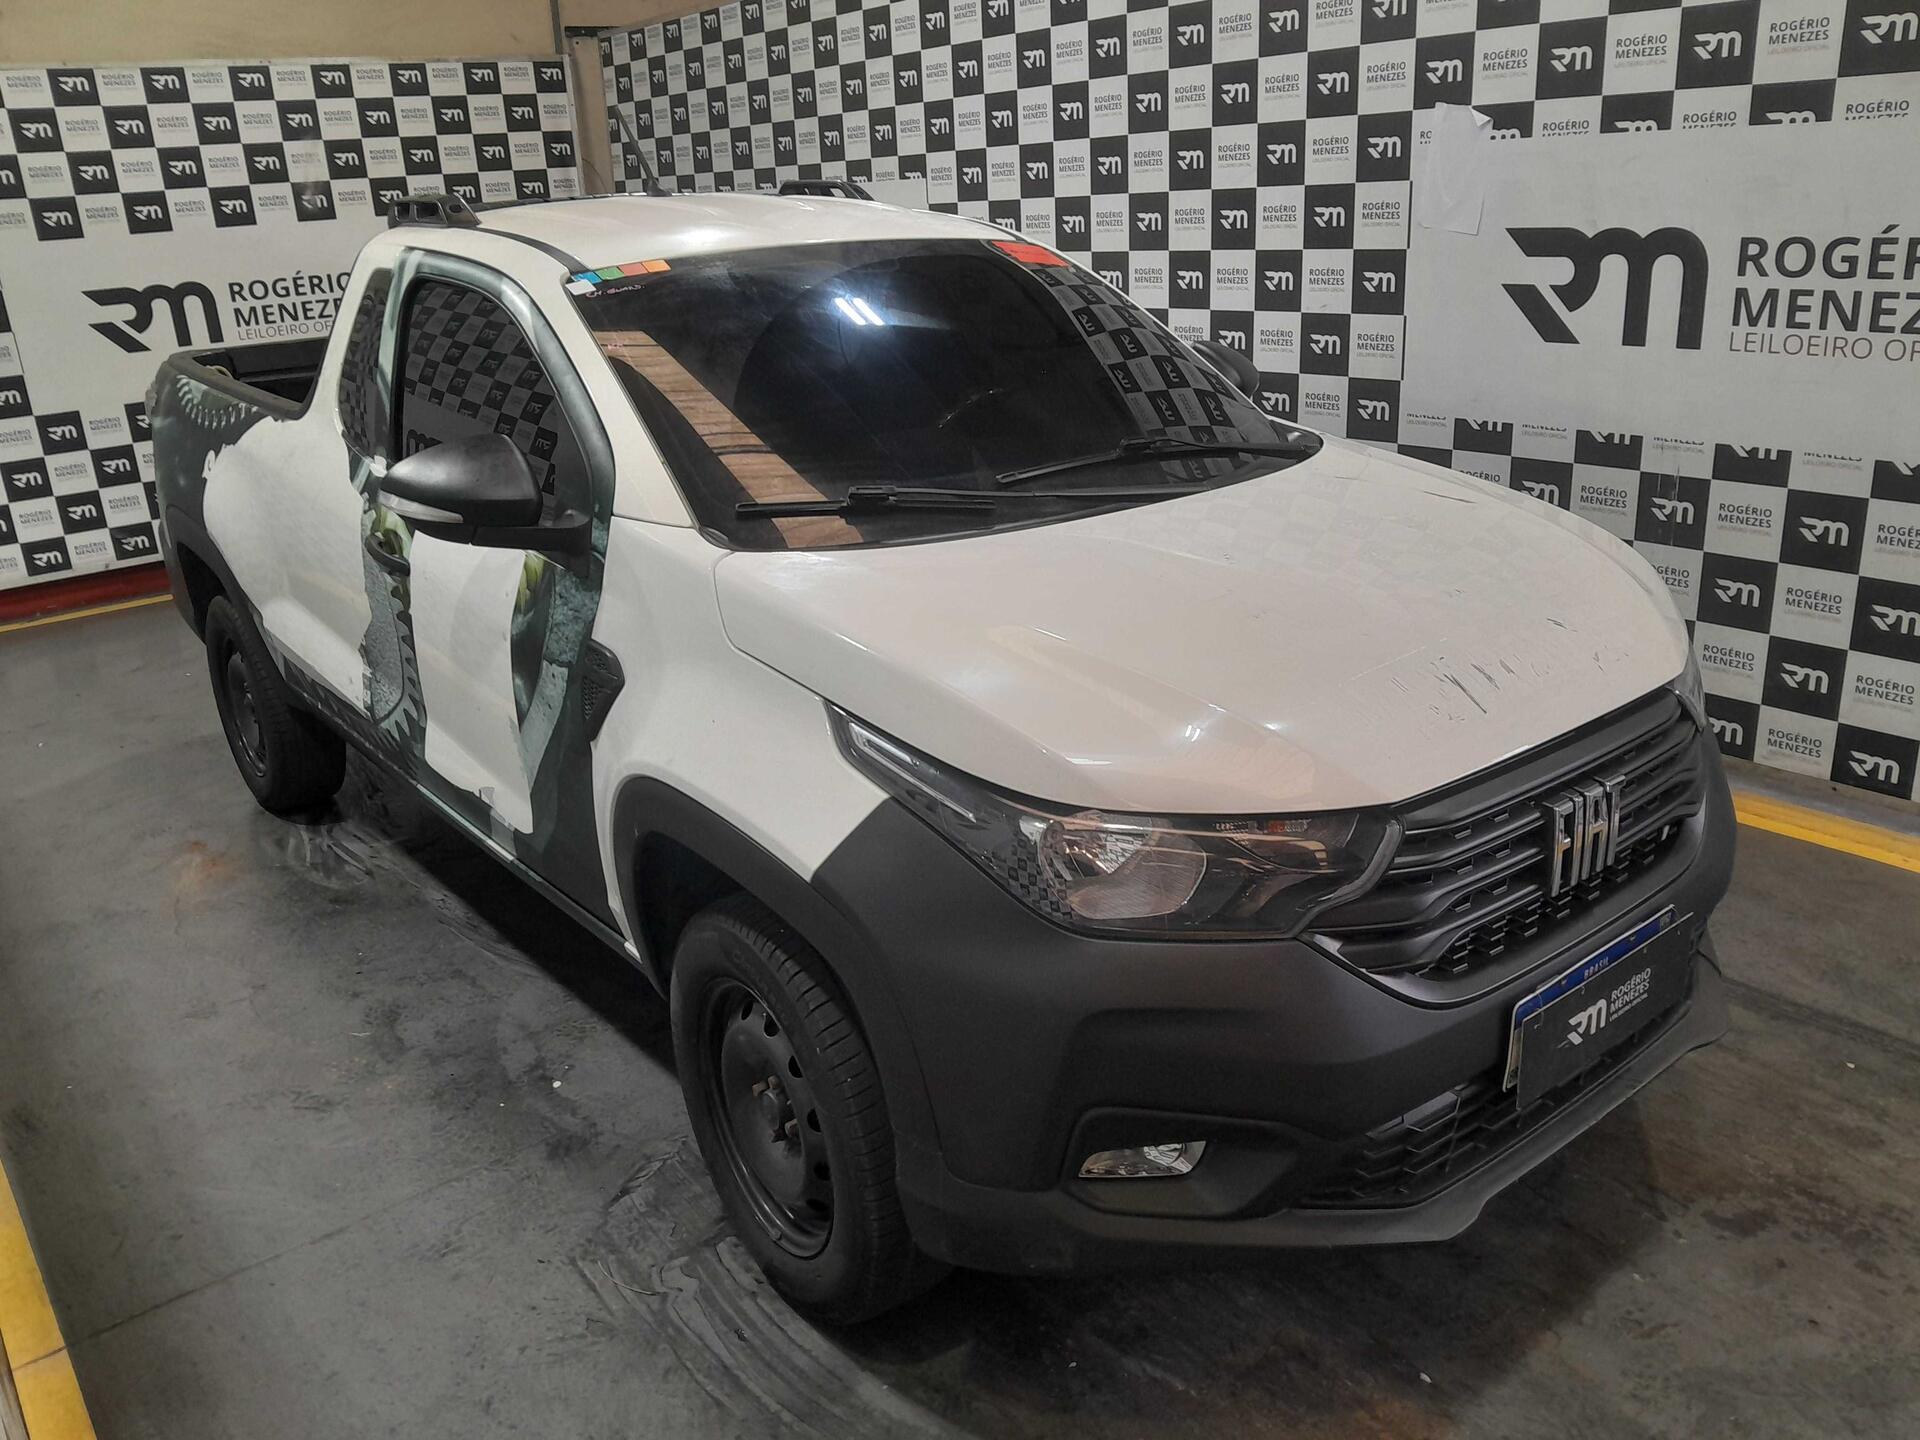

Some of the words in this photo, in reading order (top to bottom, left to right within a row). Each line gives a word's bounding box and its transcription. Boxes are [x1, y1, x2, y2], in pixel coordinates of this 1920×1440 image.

[1219, 12, 1252, 26] ROGÉRIO
[1315, 6, 1354, 20] MENEZES
[1219, 22, 1253, 34] MENEZES
[1770, 16, 1831, 33] ROGÉRIO
[1132, 26, 1162, 38] ROGÉRIO
[1768, 28, 1830, 45] MENEZES
[1132, 35, 1163, 47] MENEZES
[1616, 33, 1669, 48] ROGÉRIO
[1482, 48, 1528, 62] ROGÉRIO
[1615, 44, 1668, 59] MENEZES
[1366, 61, 1406, 74] ROGÉRIO
[1482, 58, 1528, 72] MENEZES
[1265, 73, 1300, 85] ROGÉRIO
[1366, 71, 1406, 83] MENEZES
[1174, 84, 1205, 95] ROGÉRIO
[1264, 82, 1300, 94] MENEZES
[1094, 94, 1122, 104] ROGÉRIO
[1174, 93, 1206, 104] MENEZES
[1094, 102, 1123, 112] MENEZES
[1846, 98, 1912, 113] ROGÉRIO
[1682, 109, 1738, 123] ROGÉRIO
[1541, 119, 1590, 132] ROGÉRIO
[1312, 135, 1349, 147] ROGÉRIO
[1133, 149, 1163, 159] ROGÉRIO
[1218, 143, 1251, 154] ROGÉRIO
[1312, 145, 1349, 156] MENEZES
[1133, 158, 1163, 167] MENEZES
[1218, 152, 1251, 162] MENEZES
[1175, 206, 1205, 217] ROGÉRIO
[1262, 203, 1297, 214] ROGÉRIO
[1361, 200, 1400, 211] ROGÉRIO
[1175, 216, 1206, 225] MENEZES
[1262, 213, 1297, 223] MENEZES
[1361, 211, 1400, 220] MENEZES
[1134, 266, 1163, 276] ROGÉRIO
[1216, 266, 1248, 276] ROGÉRIO
[1309, 267, 1345, 277] ROGÉRIO
[1134, 275, 1163, 284] MENEZES
[1216, 276, 1248, 284] MENEZES
[1309, 277, 1345, 286] MENEZES
[233, 297, 342, 328] MENEZ
[1732, 287, 1920, 334] MENEZ
[237, 322, 310, 341] LEILOEIRO
[1260, 328, 1293, 338] ROGÉRIO
[1357, 332, 1395, 343] ROGÉRIO
[1259, 337, 1293, 347] MENEZES
[1357, 342, 1395, 352] MENEZES
[1729, 331, 1873, 360] LEILOEIRO
[1305, 391, 1340, 403] ROGÉRIO
[1305, 400, 1340, 411] MENEZES
[1580, 485, 1628, 499] ROGÉRIO
[1580, 494, 1628, 509] MENEZES
[1718, 503, 1773, 519] ROGÉRIO
[1717, 513, 1772, 529] MENEZES
[1876, 535, 1920, 550] MENEZ
[1651, 564, 1690, 579] GÉRIO
[1662, 576, 1689, 589] EZES
[1785, 586, 1843, 604] ROGÉRIO
[1784, 596, 1842, 615] MENEZES
[1703, 643, 1756, 662] ROGÉRIO
[1702, 653, 1755, 672] MENEZES
[1855, 674, 1917, 695] ROGÉRIO
[1854, 684, 1915, 705] MENEZES
[1767, 728, 1823, 749] ROGÉRIO
[1766, 738, 1822, 759] MENEZES
[1550, 775, 1626, 898] FIAT
[1584, 956, 1609, 980] BRASIL
[1611, 967, 1652, 1001] ROGÉRIO
[1609, 978, 1650, 1014] MENEZES
